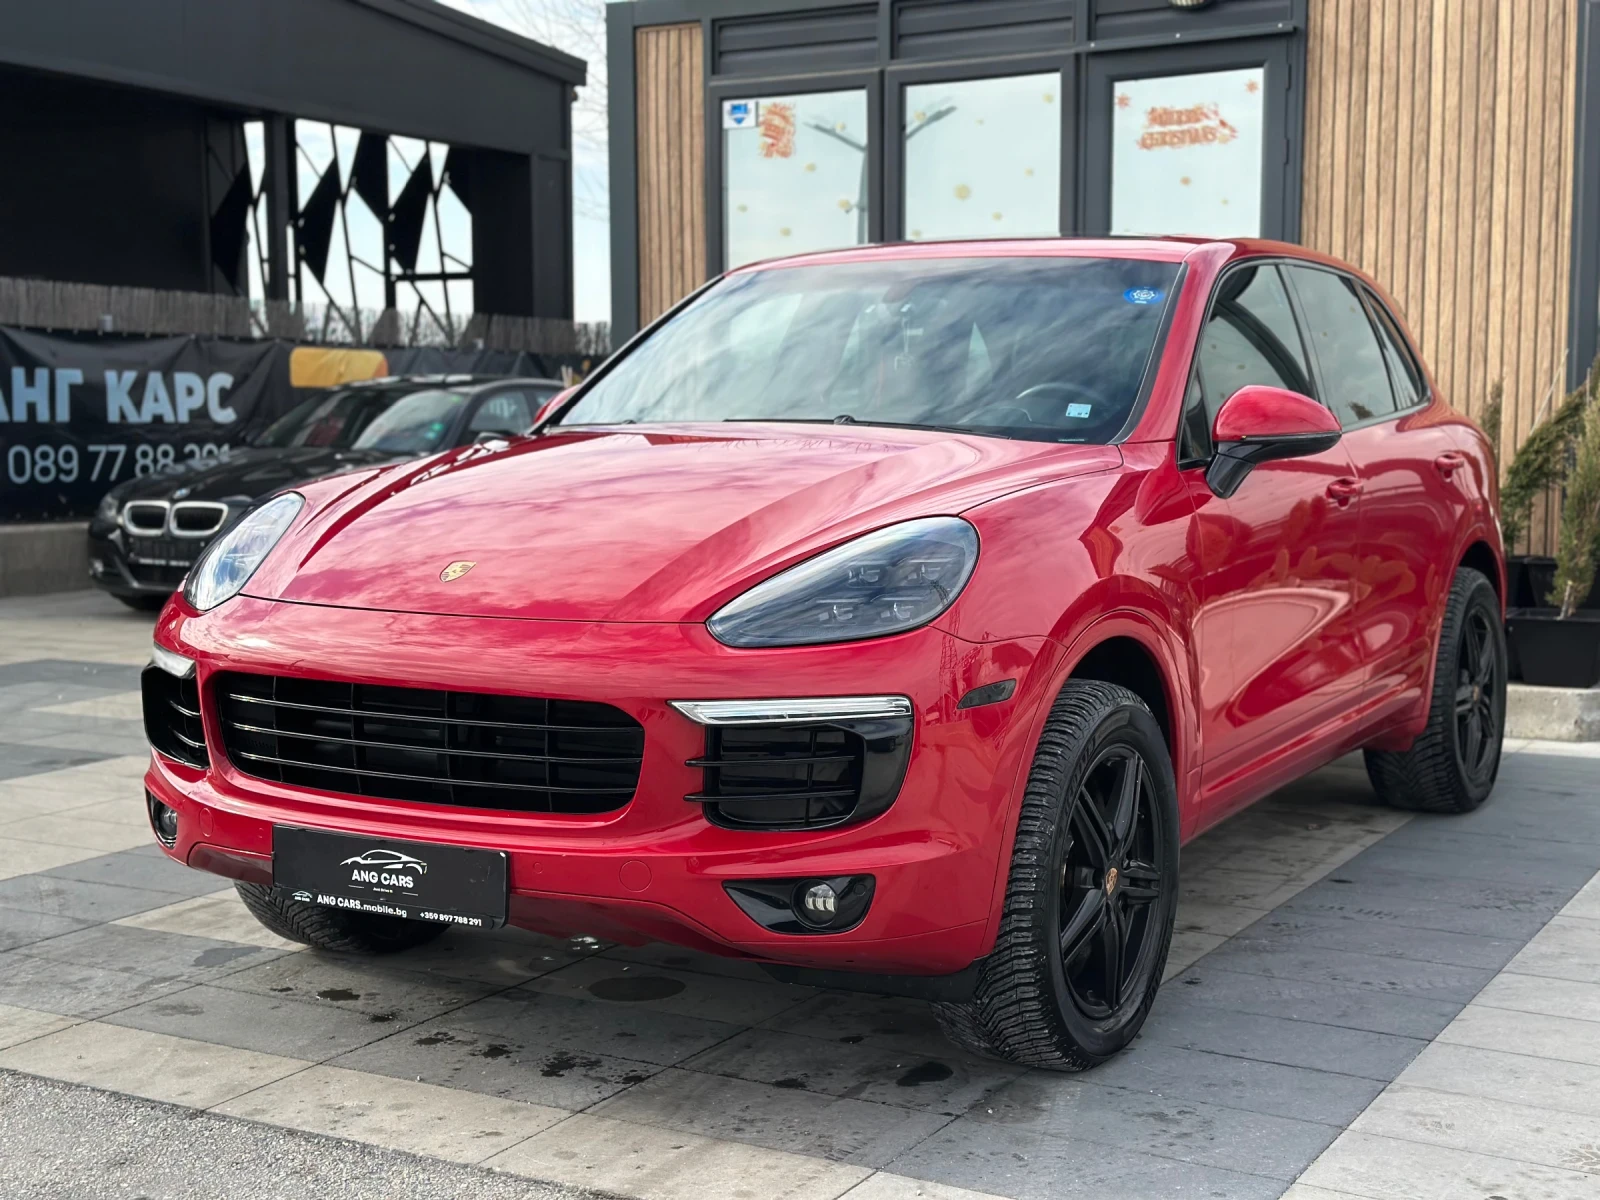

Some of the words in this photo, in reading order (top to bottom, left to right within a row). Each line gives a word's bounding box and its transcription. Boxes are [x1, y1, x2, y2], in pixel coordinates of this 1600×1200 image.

[0, 366, 84, 423] НГ
[104, 370, 238, 424] КАРС
[8, 444, 79, 484] 089
[87, 445, 127, 482] 77
[351, 869, 379, 884] ANG
[380, 872, 414, 889] CARS
[317, 894, 337, 906] ANG
[337, 897, 408, 918] CARS.mobile.bg
[420, 911, 439, 920] +359
[439, 913, 453, 923] 897
[453, 915, 468, 925] 788
[468, 917, 482, 927] 291
